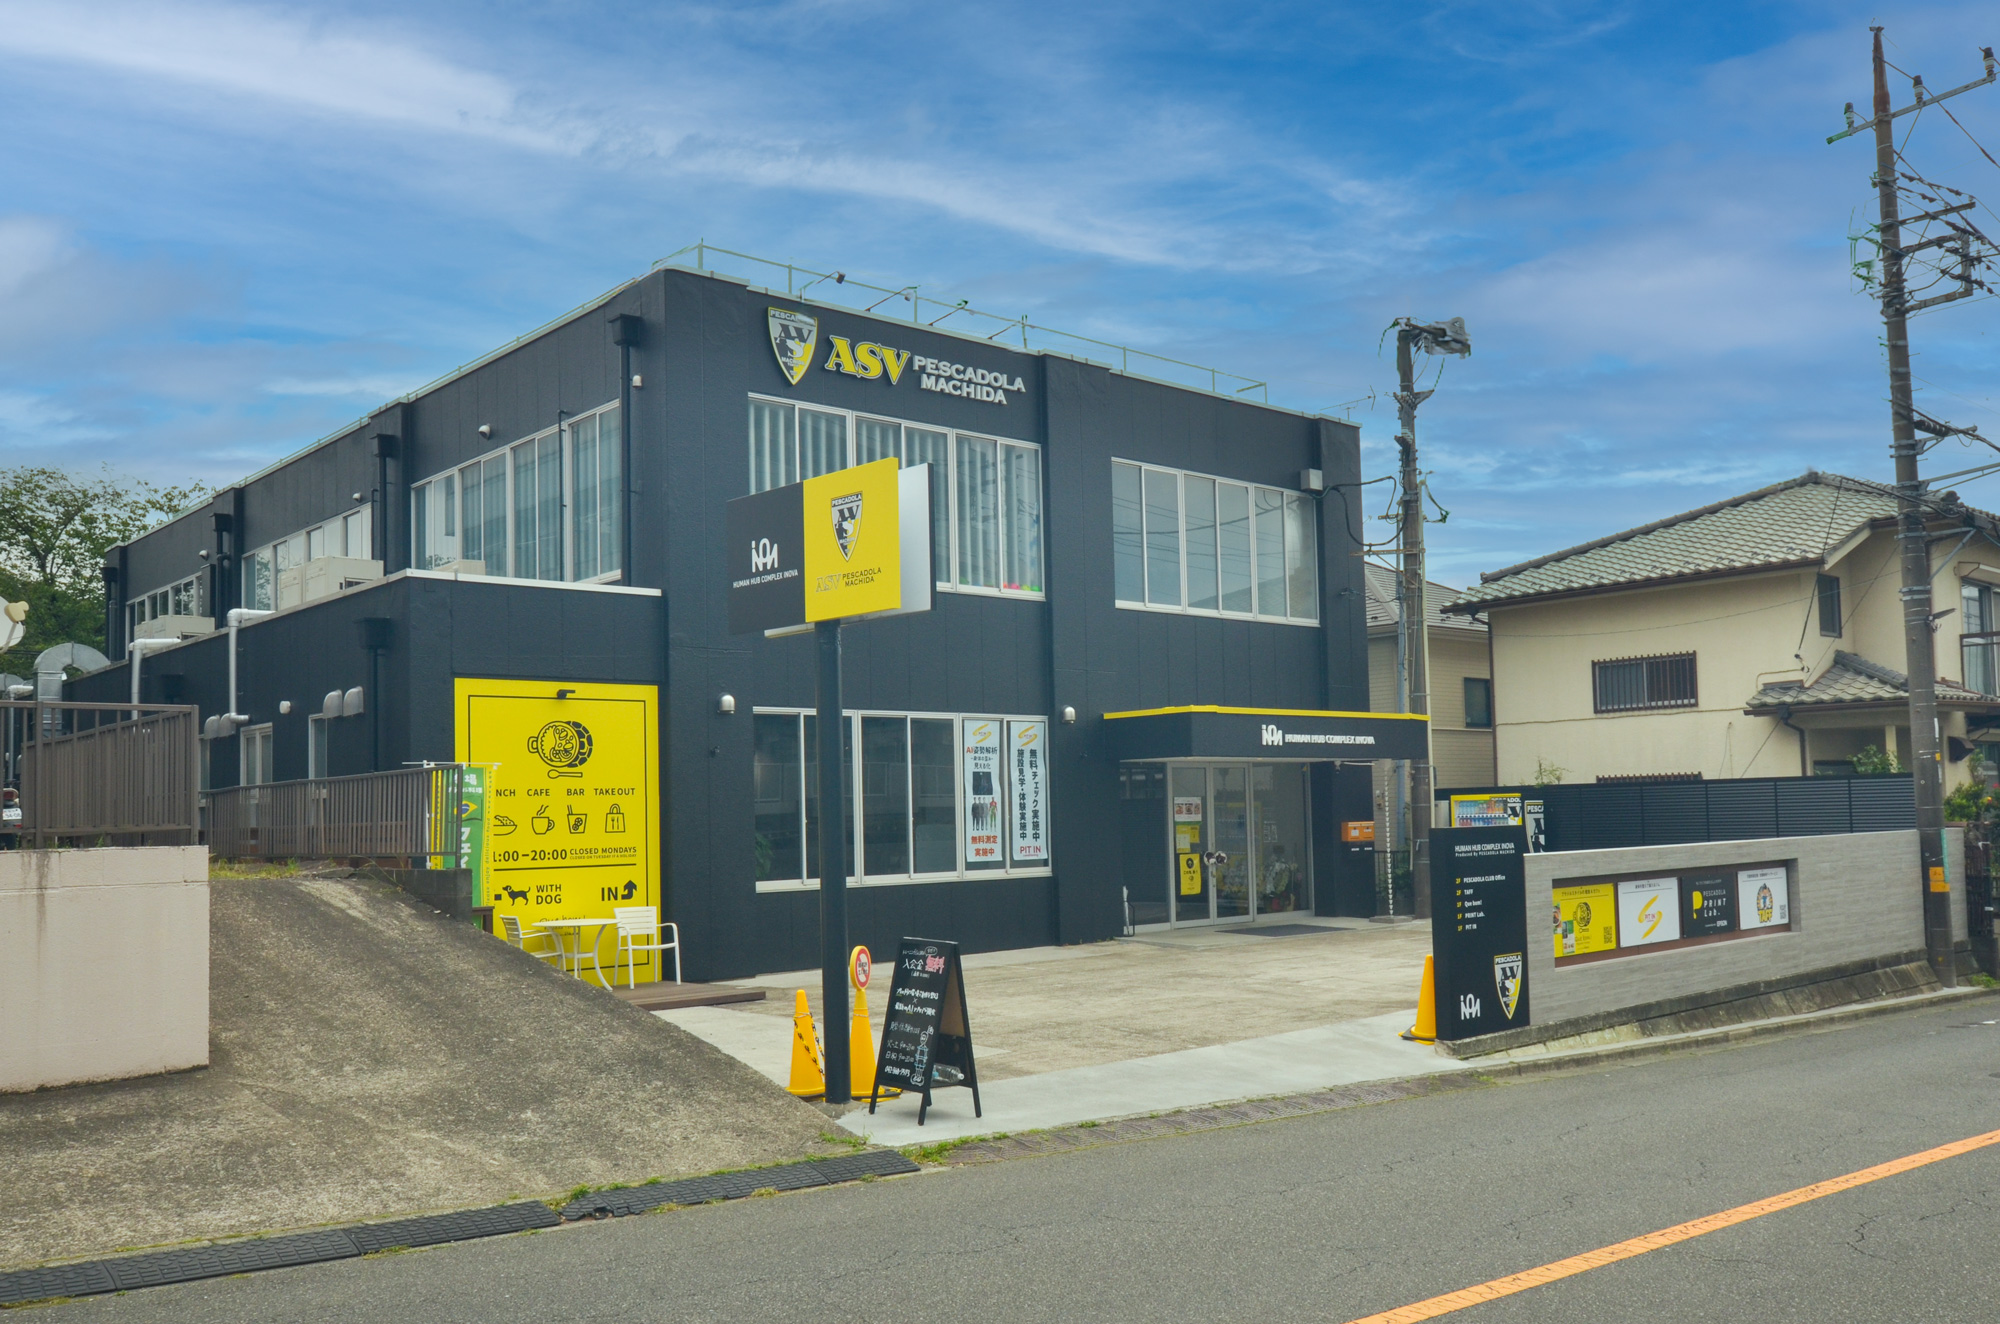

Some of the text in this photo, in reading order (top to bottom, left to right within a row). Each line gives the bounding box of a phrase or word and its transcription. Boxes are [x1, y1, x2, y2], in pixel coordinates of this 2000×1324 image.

[824, 335, 1026, 393] ASV PESCADOLA
[920, 373, 1008, 405] MACHIDA
[831, 493, 862, 506] PESCADOLA
[842, 567, 882, 580] PESCADOLA
[732, 579, 750, 589] HUMAN
[750, 576, 761, 585] HUB
[761, 572, 783, 583] COMPLEX
[844, 576, 875, 587] MACHIDA
[1285, 733, 1311, 743] HUMAN
[1311, 734, 1326, 744] HUB
[1326, 735, 1355, 744] COMPLEX
[495, 788, 517, 797] NCH
[526, 788, 551, 797] CAFE
[566, 788, 585, 796] BAR
[1017, 748, 1027, 841] 施設見学・体験実施中
[1029, 748, 1040, 842] 無料チェック実施中
[971, 835, 998, 844] 無料測定
[601, 846, 637, 854] MONDAYS
[974, 847, 995, 857] 実施中
[1019, 845, 1042, 854] PIT IN
[1454, 845, 1472, 853] HUMAN
[1472, 843, 1481, 852] HUB
[1481, 842, 1501, 851] COMPLEX
[535, 884, 562, 893] WITH
[601, 886, 619, 902] IN
[1703, 889, 1726, 897] PESCADOLA
[535, 894, 562, 905] DOG
[1703, 898, 1727, 908] PRINT
[1704, 909, 1721, 917] Lab.
[1757, 908, 1773, 923] TAFF
[1495, 954, 1522, 964] PESCADOLA
